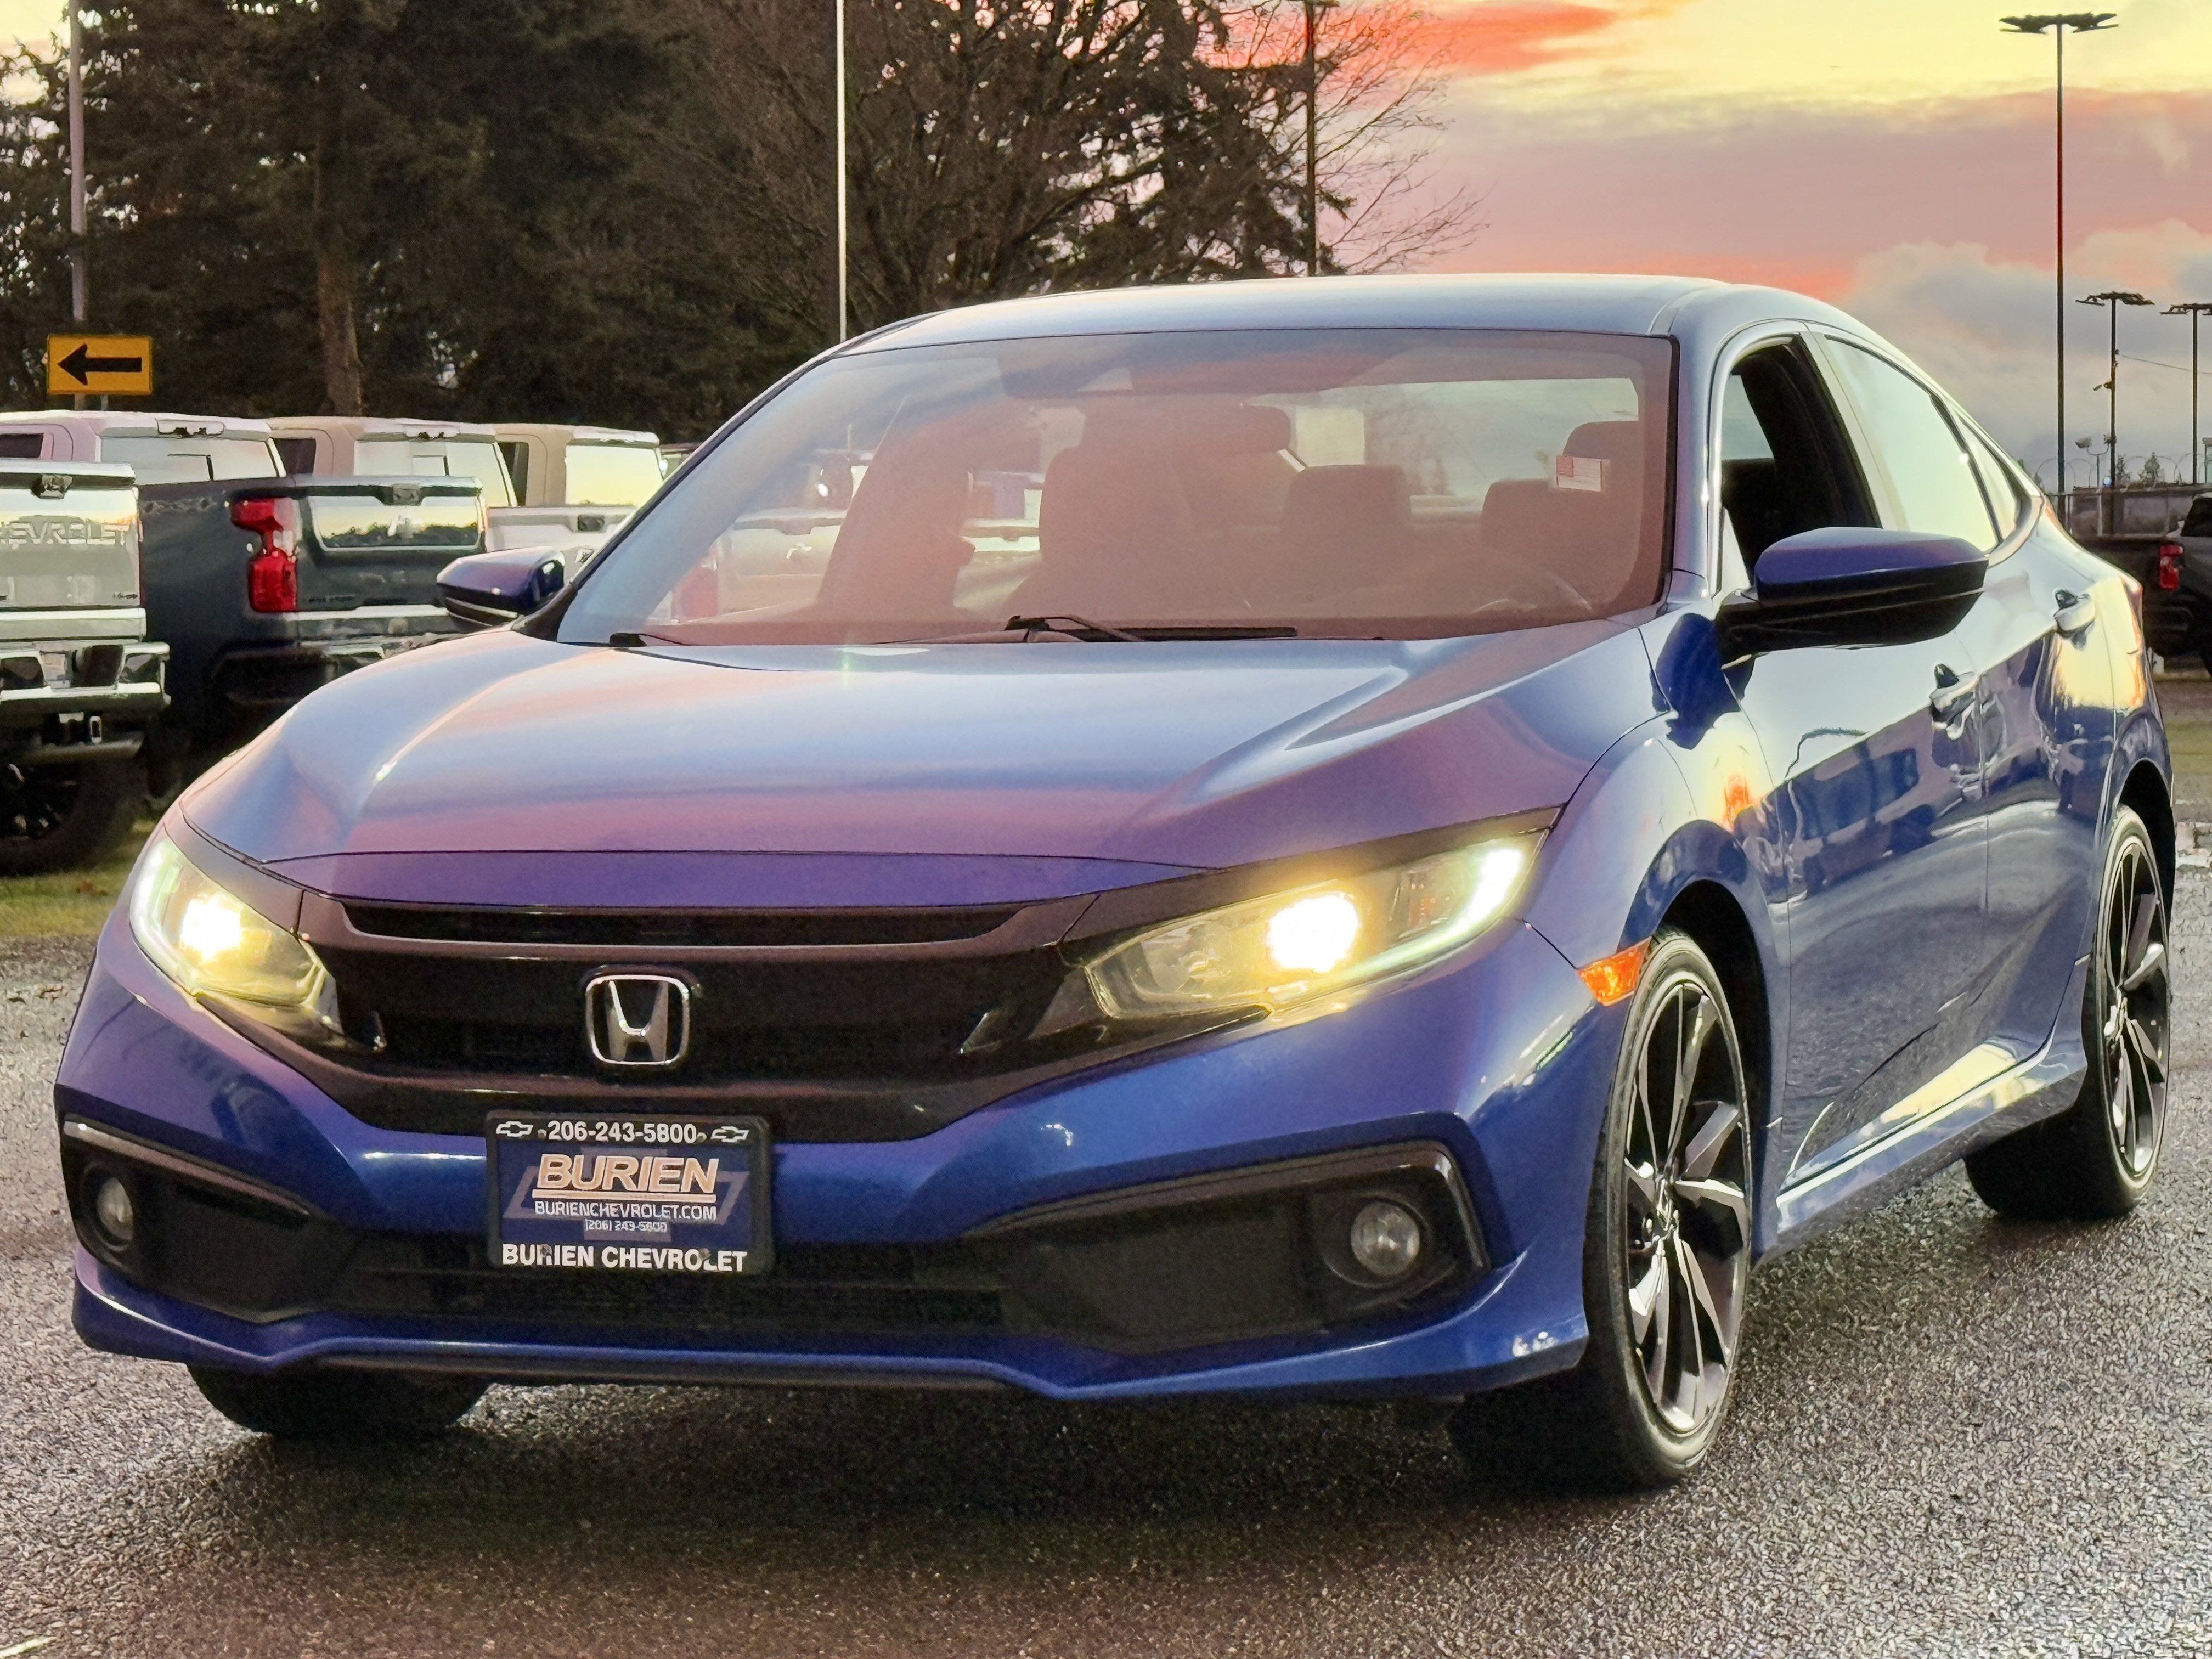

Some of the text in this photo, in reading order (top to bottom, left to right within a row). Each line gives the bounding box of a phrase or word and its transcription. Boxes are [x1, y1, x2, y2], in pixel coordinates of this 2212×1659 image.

[548, 1120, 697, 1143] 206-243-5800
[537, 1154, 719, 1193] BURIEN
[535, 1200, 716, 1220] BURIENCHEVROLET.COM
[503, 1244, 594, 1267] BURIEN
